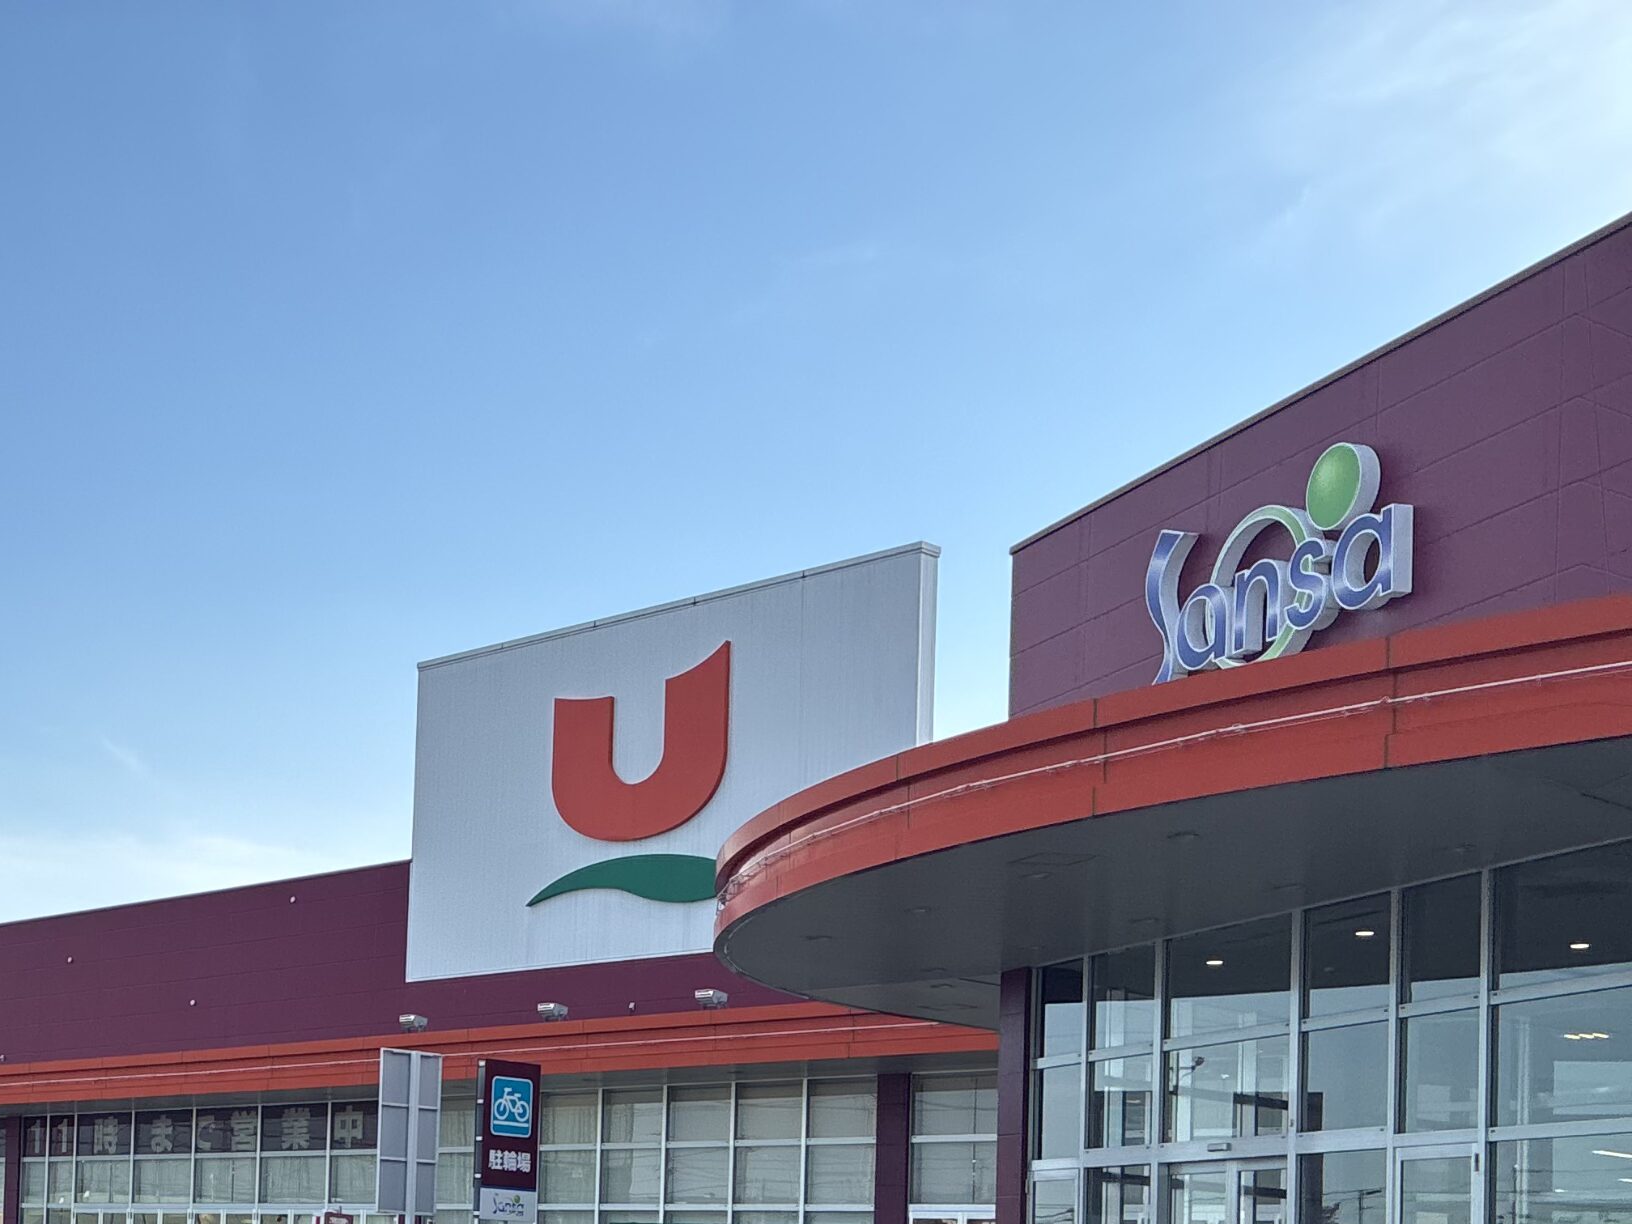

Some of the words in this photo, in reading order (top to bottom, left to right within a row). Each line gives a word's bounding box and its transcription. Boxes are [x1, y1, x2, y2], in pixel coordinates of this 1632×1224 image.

[551, 640, 731, 842] U
[488, 1149, 531, 1173] 駐輪場
